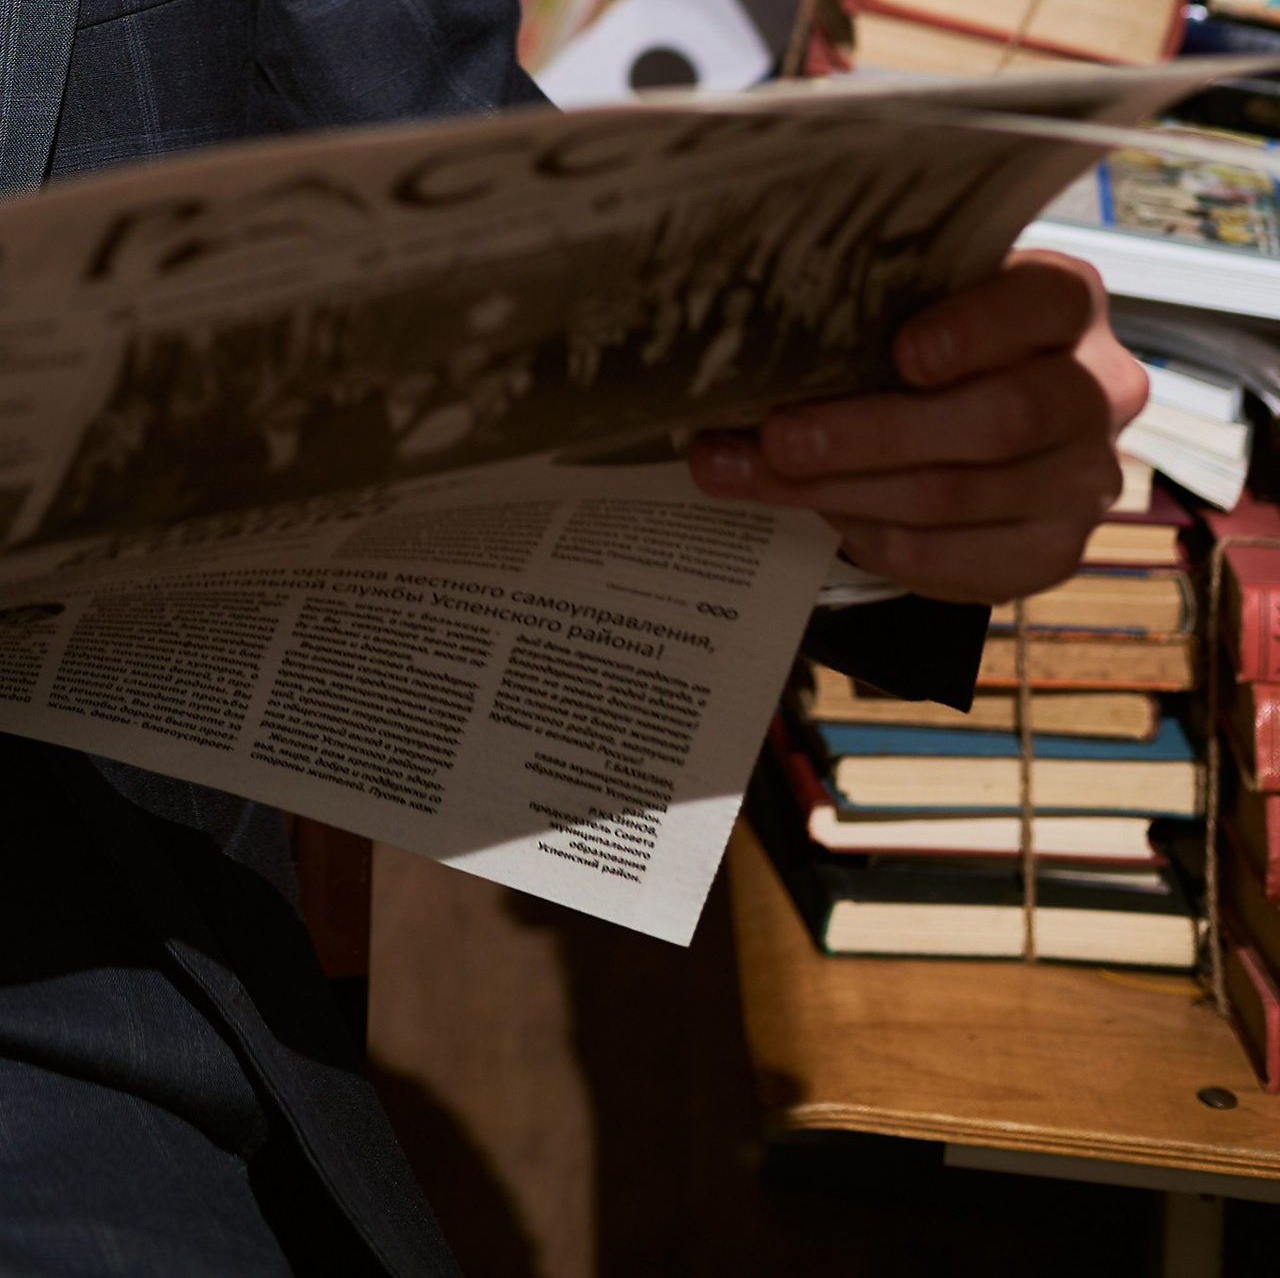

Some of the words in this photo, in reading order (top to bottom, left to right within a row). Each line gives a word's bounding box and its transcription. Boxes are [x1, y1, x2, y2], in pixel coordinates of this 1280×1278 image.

[292, 565, 388, 582] органов
[394, 572, 506, 599] местного
[510, 589, 716, 654] самоуправления,
[332, 579, 424, 604] службы
[431, 591, 562, 633] Успенского
[567, 625, 666, 661] района!
[55, 674, 113, 689] жителей
[188, 700, 221, 715] пути
[130, 667, 173, 681] малой
[74, 696, 117, 710] чтобы
[119, 705, 163, 722] дороги
[164, 714, 197, 730] были
[198, 725, 237, 743] проез-
[152, 703, 225, 726] отвечаете
[191, 688, 250, 711] просьбы
[281, 700, 377, 736] общественного
[89, 709, 131, 725] дворы
[140, 720, 235, 754] благоустроен-
[259, 718, 319, 743] развитие
[321, 734, 387, 761] Успенского
[386, 753, 437, 778] района!
[347, 730, 383, 748] вклад
[269, 730, 319, 752] Желаем
[320, 747, 345, 761] вам
[346, 756, 403, 781] крепкого
[249, 750, 305, 774] стороны
[306, 765, 367, 792] жителей.
[367, 785, 407, 808] Пусть
[313, 756, 350, 777] добра
[360, 771, 428, 802] поддержки
[549, 821, 651, 862] муниципального
[568, 838, 646, 873] образования
[614, 828, 655, 848] Совета
[537, 841, 599, 869] Успенский
[601, 863, 642, 885] район.
